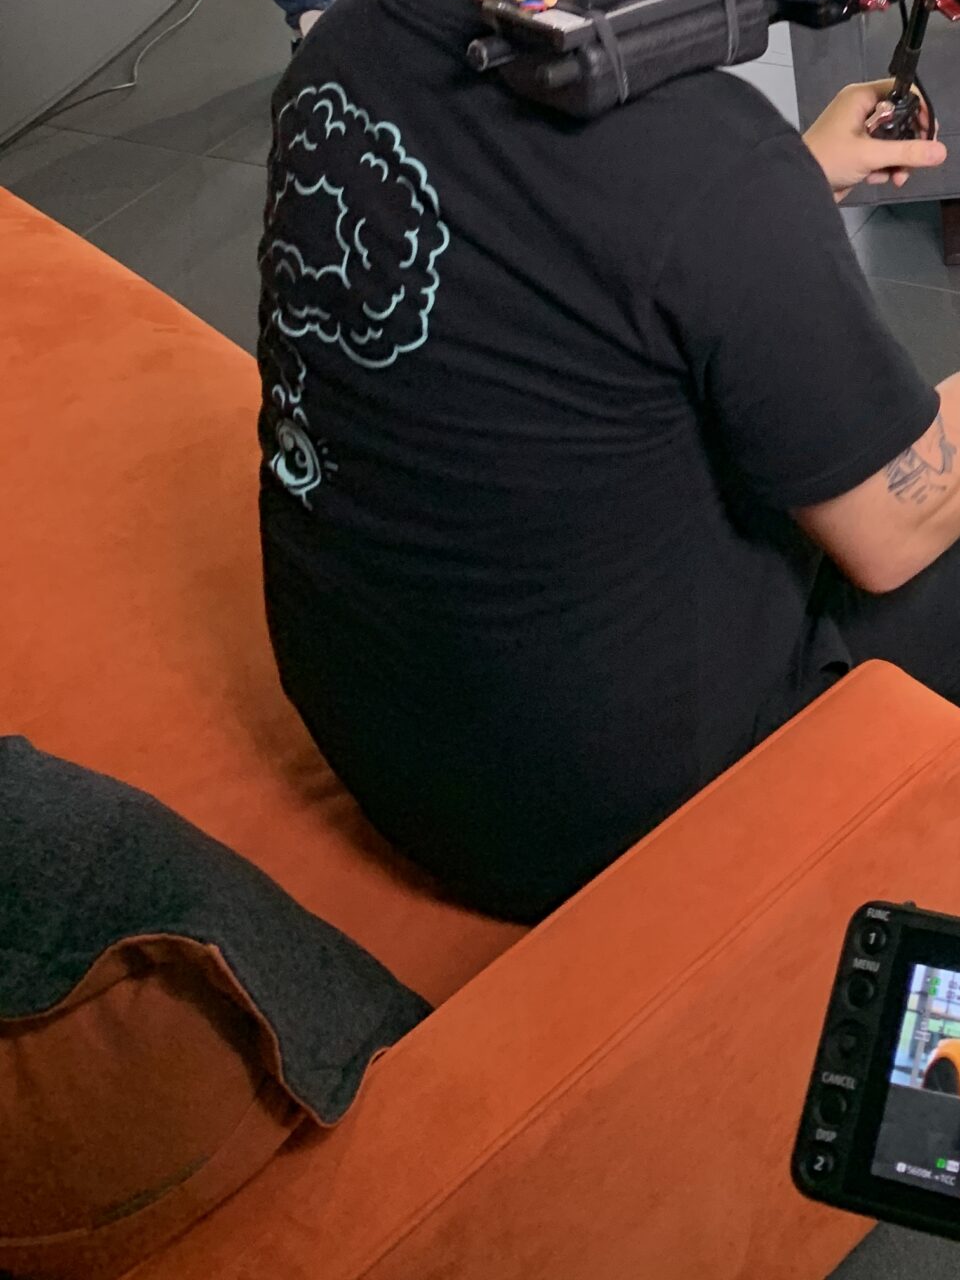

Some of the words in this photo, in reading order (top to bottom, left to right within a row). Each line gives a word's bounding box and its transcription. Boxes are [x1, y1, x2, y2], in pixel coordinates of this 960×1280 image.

[868, 931, 877, 945] 1
[852, 957, 881, 973] MENU
[821, 1071, 857, 1090] CANCEL
[813, 1155, 825, 1172] 2
